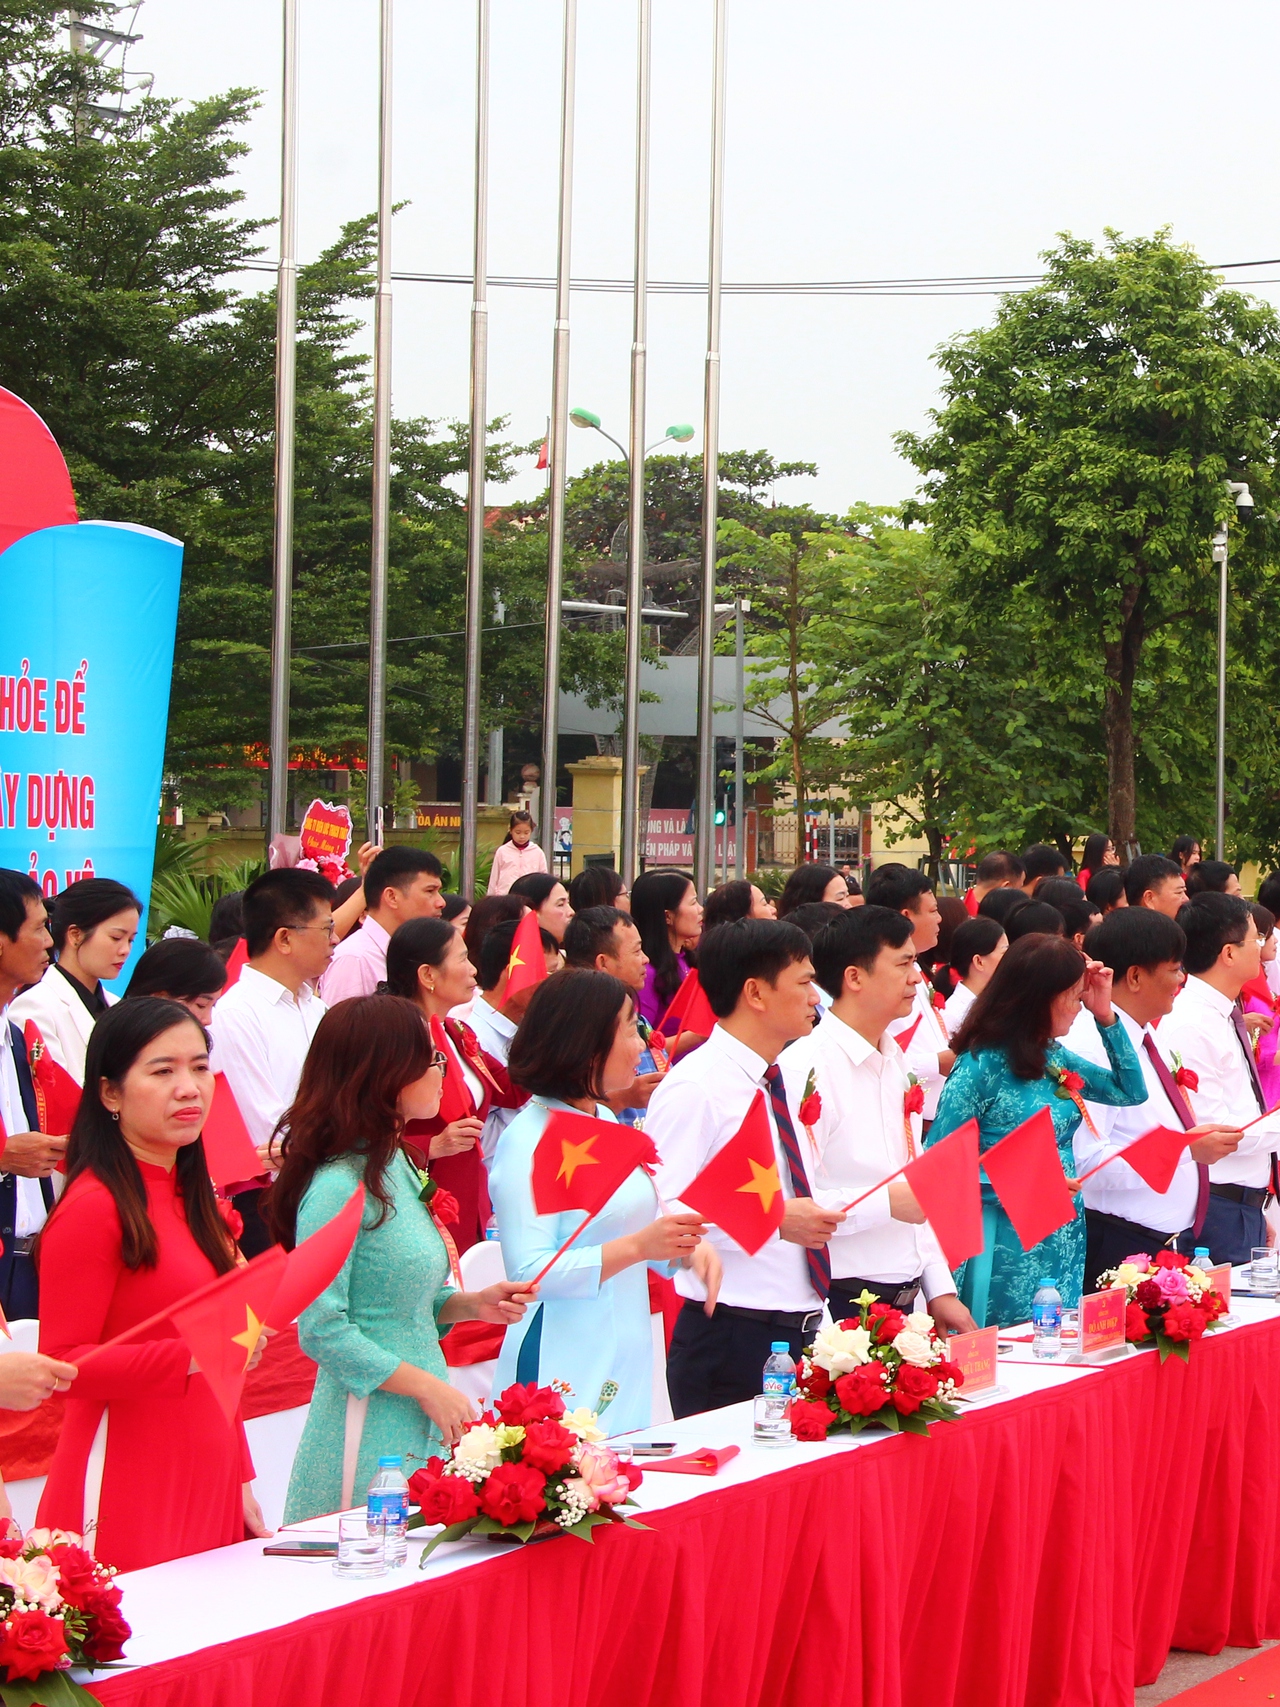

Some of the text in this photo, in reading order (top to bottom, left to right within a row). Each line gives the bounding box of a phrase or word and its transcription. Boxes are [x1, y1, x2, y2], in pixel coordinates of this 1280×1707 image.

[0, 658, 88, 735] HỎE ĐỂ
[0, 765, 95, 842] Y DỰNG
[416, 813, 431, 827] ÒA
[433, 813, 449, 827] ÁN
[664, 817, 675, 834] VÀ
[677, 817, 688, 834] LÀ
[658, 840, 681, 857] PHÁP
[682, 840, 693, 857] VÀ
[718, 840, 737, 860] LẬT
